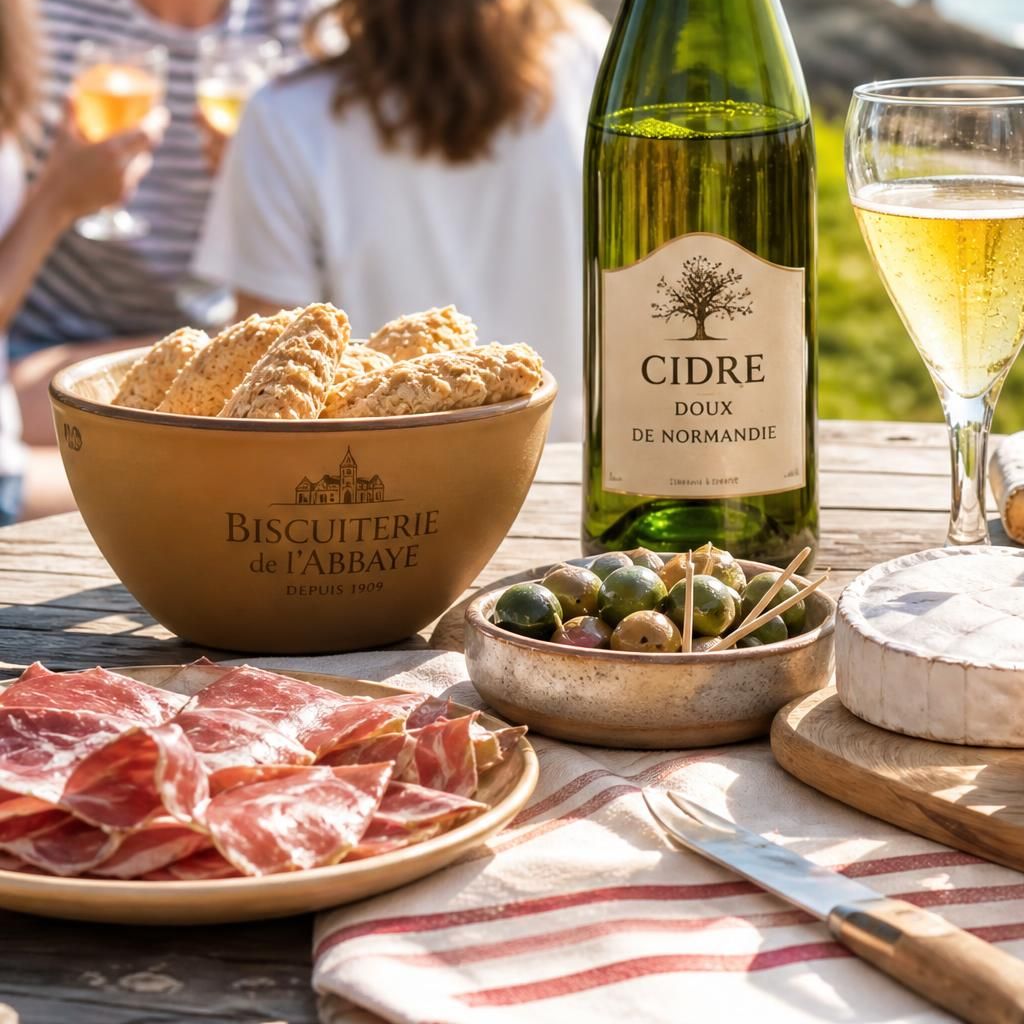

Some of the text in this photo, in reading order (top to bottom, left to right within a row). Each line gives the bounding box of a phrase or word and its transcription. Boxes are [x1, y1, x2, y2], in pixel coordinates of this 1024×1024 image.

[641, 353, 766, 385] CIDRE
[675, 400, 733, 417] DOUX
[632, 425, 777, 444] DE NORMANDIE
[225, 510, 440, 544] BISCUITERIE
[249, 551, 278, 574] de
[285, 580, 384, 597] DEPUIS 1909
